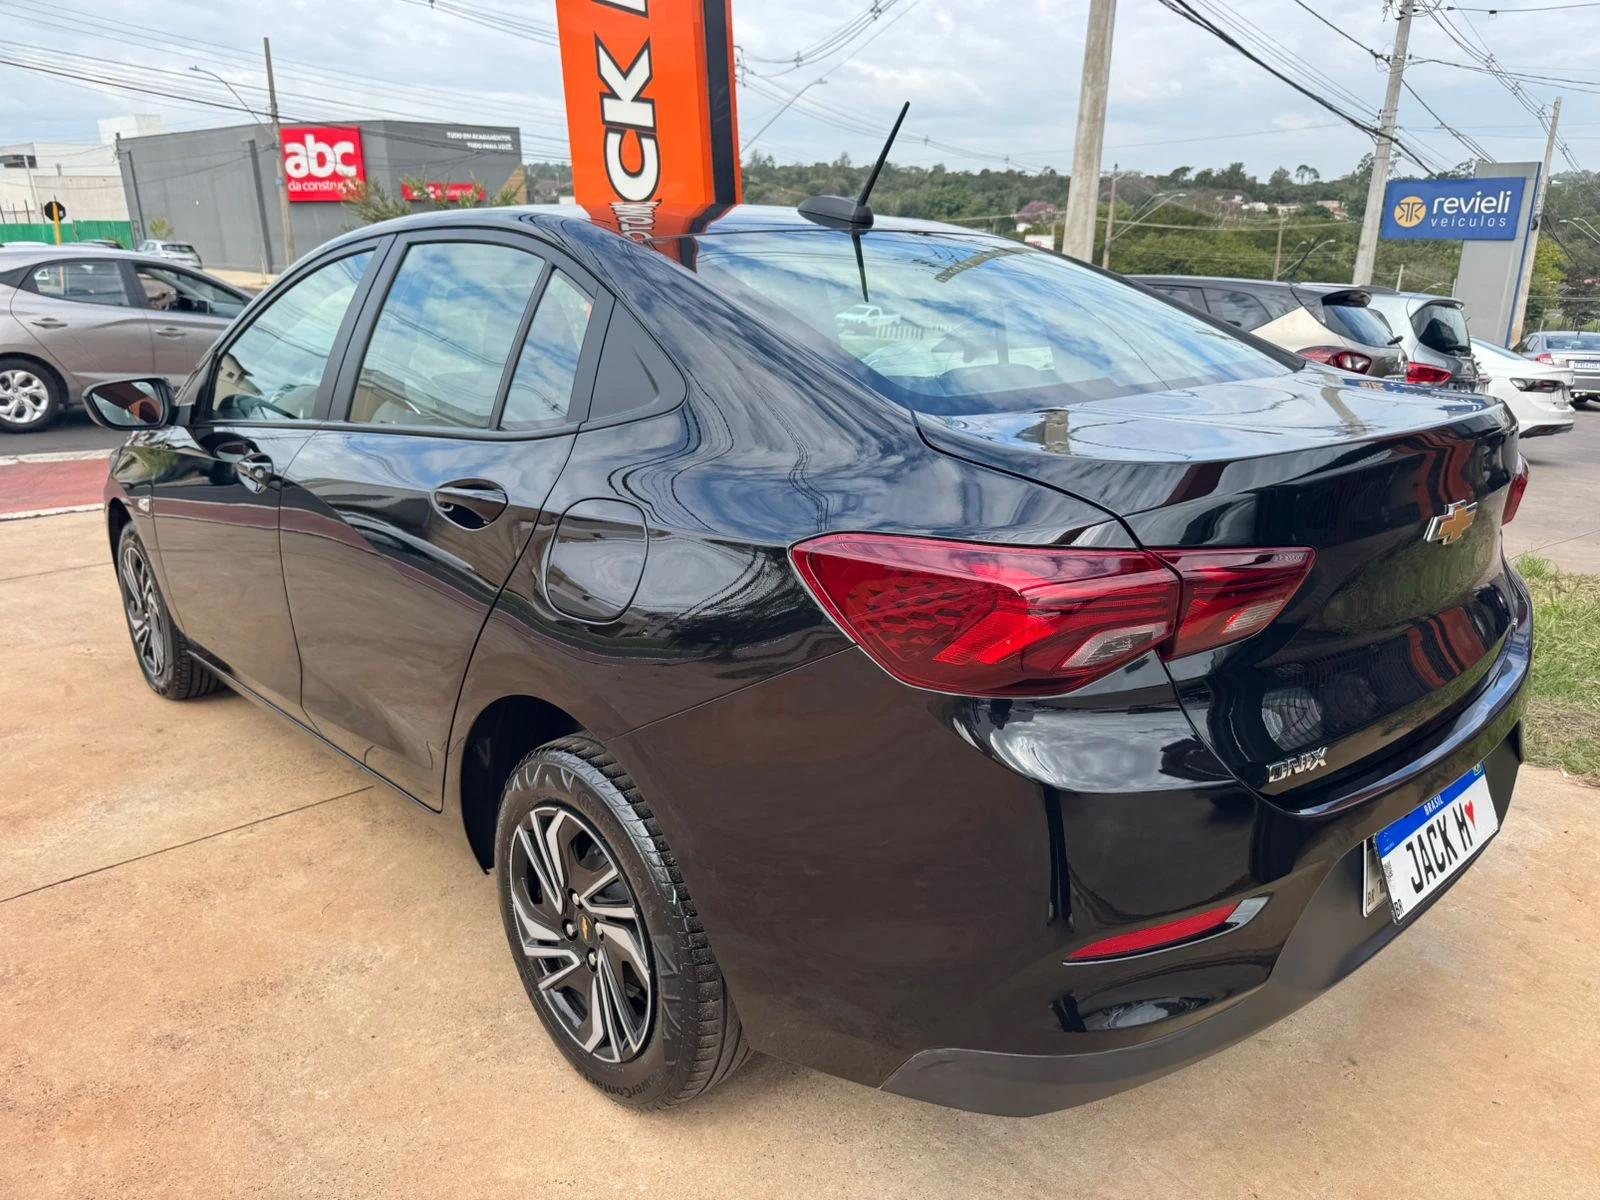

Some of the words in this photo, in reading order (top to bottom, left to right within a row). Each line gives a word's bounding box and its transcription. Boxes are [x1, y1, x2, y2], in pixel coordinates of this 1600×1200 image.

[284, 133, 357, 178] abc
[287, 180, 302, 191] da
[1432, 190, 1512, 214] revieli
[1431, 215, 1506, 228] veículos
[1265, 746, 1328, 784] ONIX
[1423, 794, 1444, 816] BRASIL
[1405, 814, 1458, 894] JACK
[1452, 802, 1473, 851] M
[1394, 898, 1405, 917] BR
